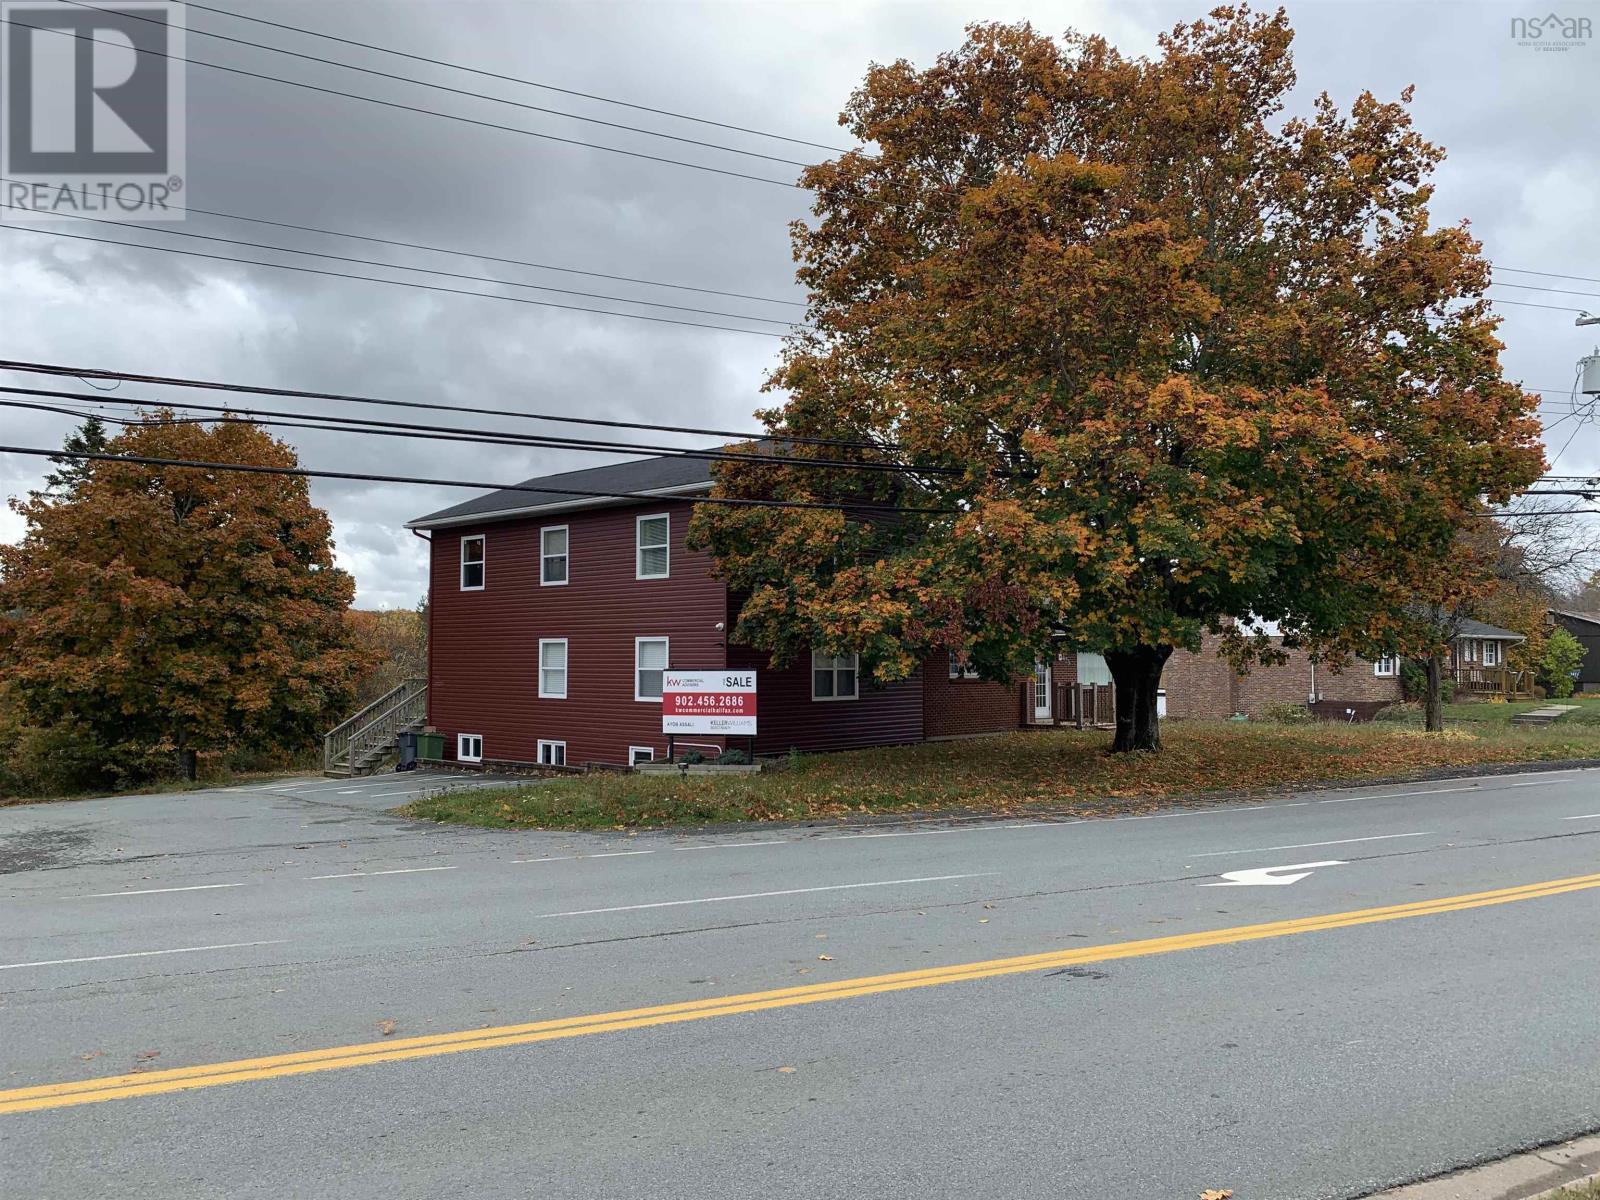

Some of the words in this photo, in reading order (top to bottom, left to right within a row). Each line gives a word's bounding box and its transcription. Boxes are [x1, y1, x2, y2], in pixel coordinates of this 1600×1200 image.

[666, 676, 682, 687] kw
[726, 677, 752, 687] SALE
[675, 696, 744, 706] 902.456.2686
